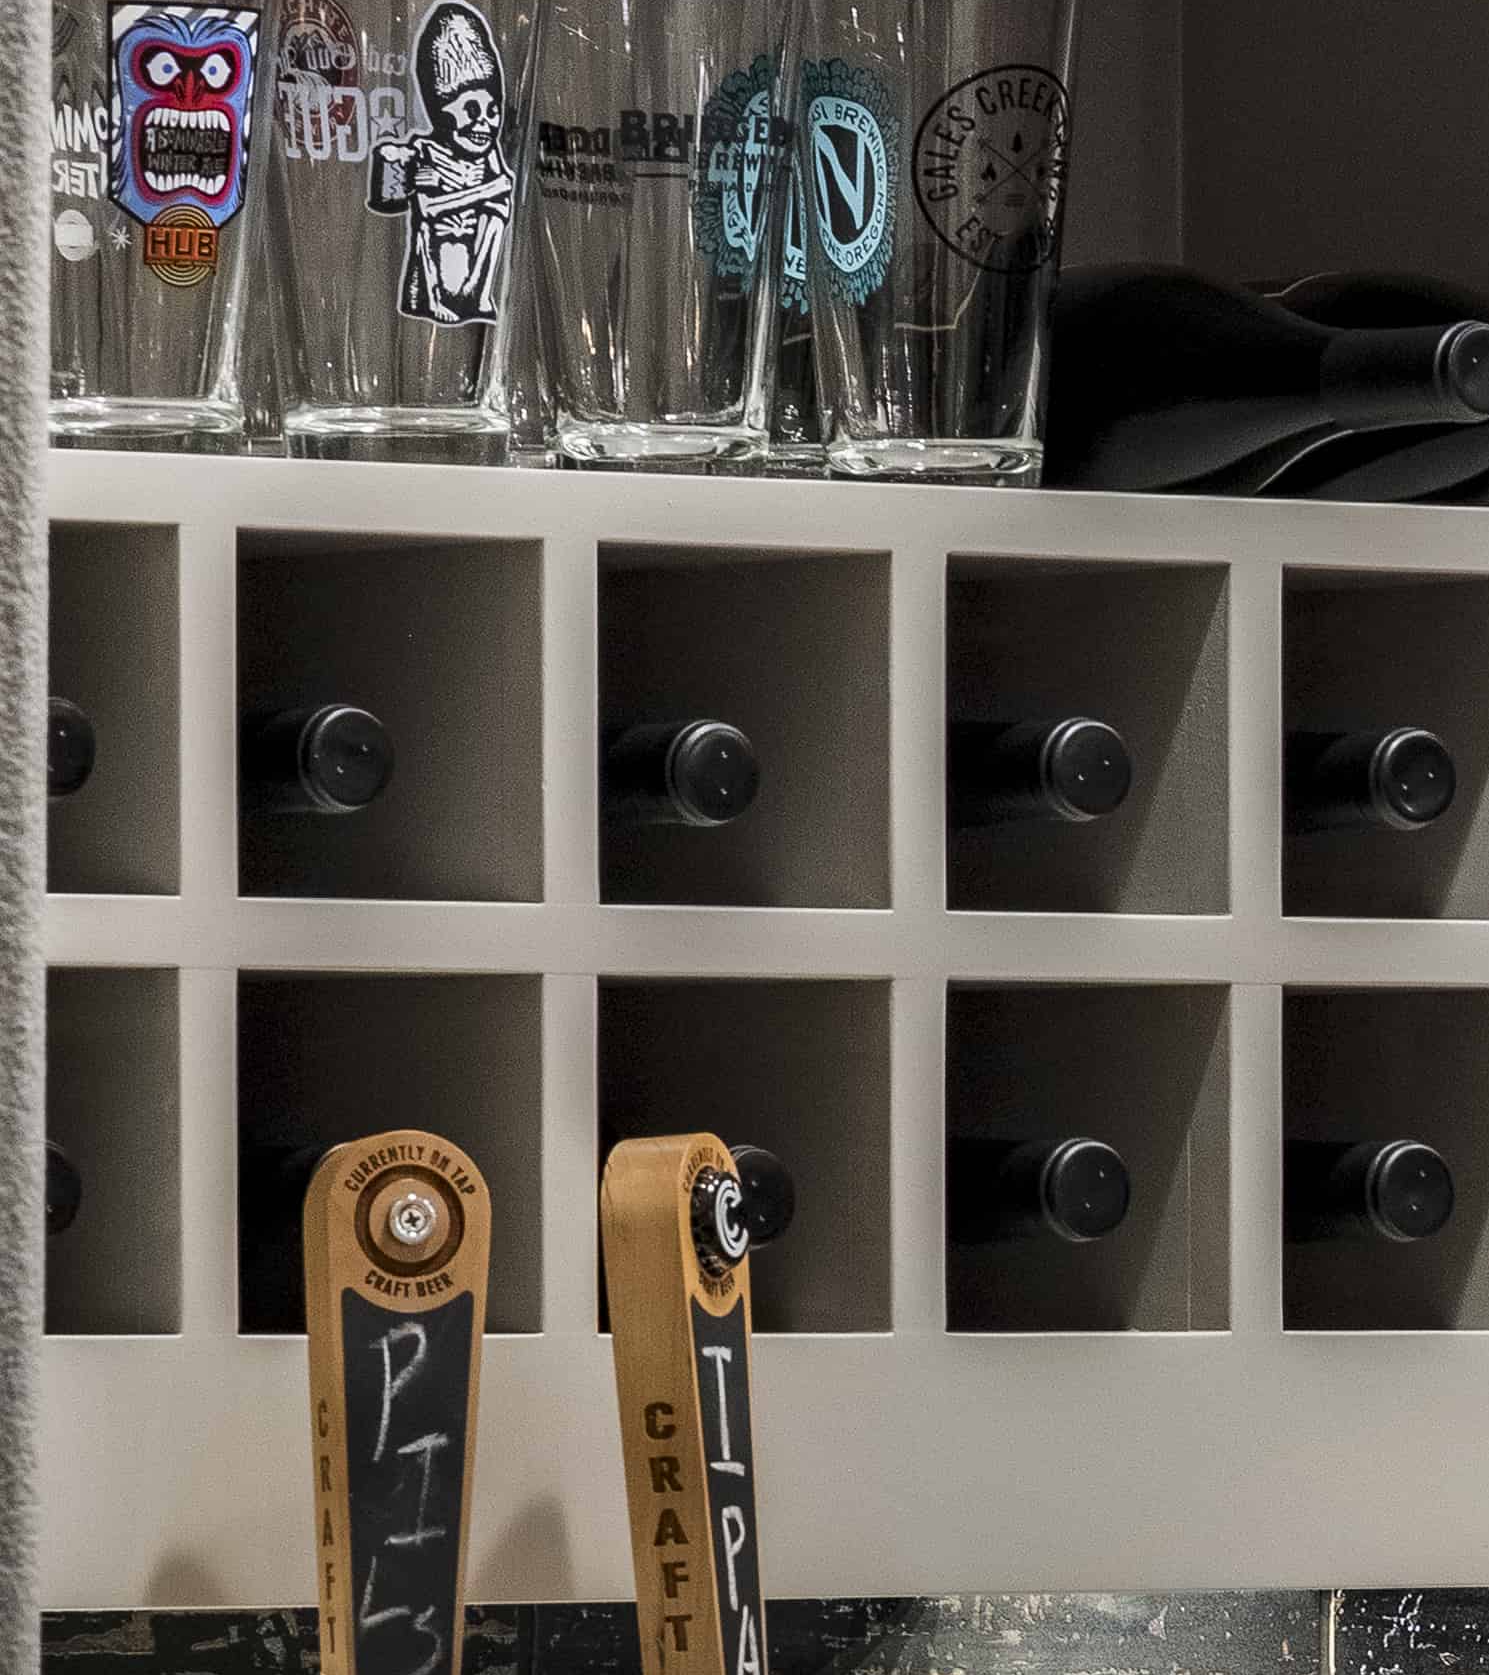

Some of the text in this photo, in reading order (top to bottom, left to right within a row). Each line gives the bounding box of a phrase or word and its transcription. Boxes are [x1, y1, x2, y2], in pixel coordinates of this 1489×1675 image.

[975, 78, 1062, 117] CREEK
[924, 105, 975, 202] GALES
[150, 227, 214, 257] HUB
[344, 1144, 477, 1195] CURRENTLY ON TAP
[364, 1269, 454, 1298] CRAFT BEER
[316, 1396, 339, 1657] CRAFT
[644, 1400, 691, 1655] CRAFT
